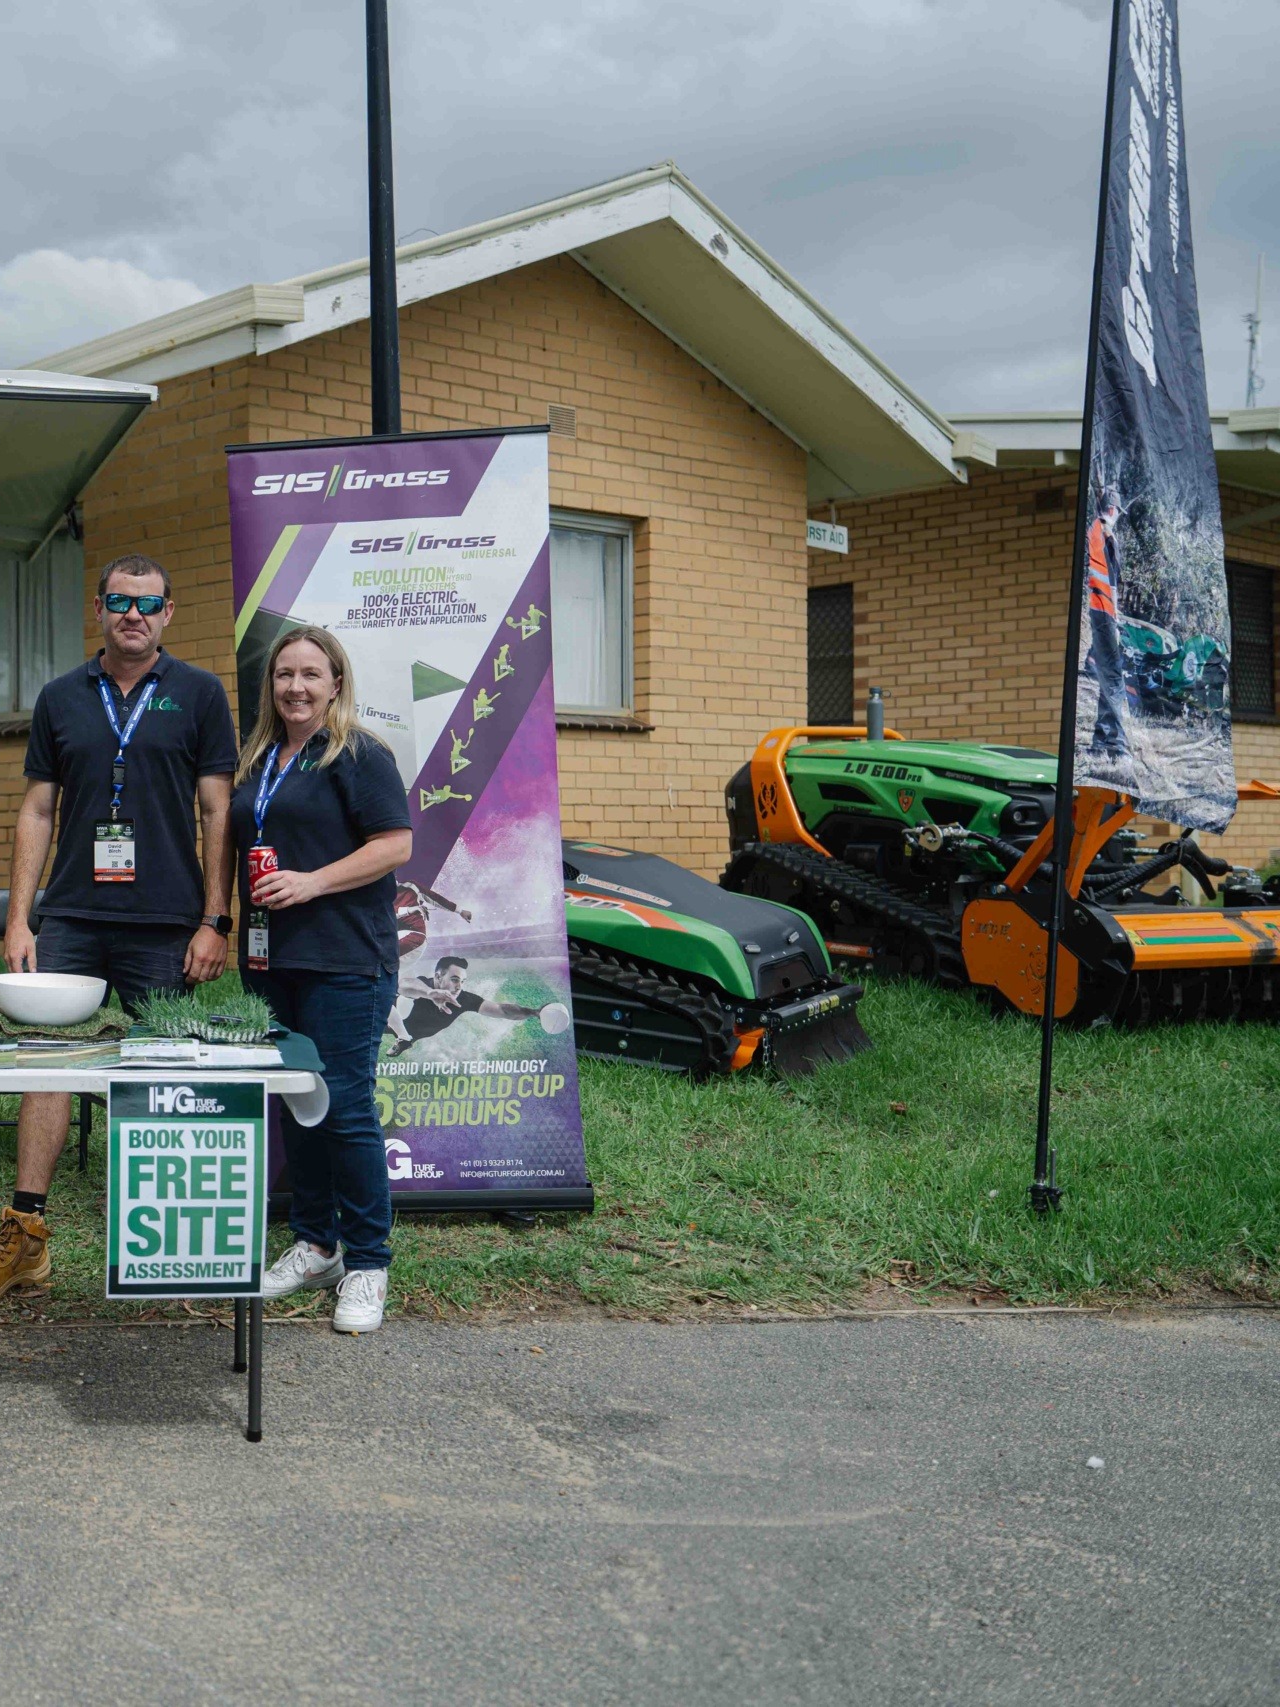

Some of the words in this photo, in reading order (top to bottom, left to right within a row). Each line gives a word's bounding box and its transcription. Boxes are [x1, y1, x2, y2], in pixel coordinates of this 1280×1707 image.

[251, 472, 326, 495] SIS
[343, 470, 450, 490] Grass
[806, 525, 827, 541] IRST
[829, 531, 845, 545] AID
[350, 536, 405, 554] SIS
[417, 535, 496, 549] Grass
[461, 548, 517, 559] UNIVERSAL
[352, 567, 447, 587] REVOLUTION
[447, 566, 454, 574] IN
[447, 573, 472, 581] HYBRID
[380, 584, 416, 594] SURFACE
[419, 582, 456, 591] SYSTEMS
[362, 594, 399, 608] 100%
[401, 590, 458, 606] ELECTRIC
[347, 606, 397, 620] BESPOKE
[400, 603, 476, 617] INSTALLATION
[362, 618, 396, 629] VARIETY
[397, 618, 408, 627] OF
[409, 616, 428, 626] NEW
[429, 614, 487, 625] APPLICATIONS
[366, 706, 400, 722] Grass
[871, 764, 909, 780] 600
[422, 1061, 459, 1075] PITCH
[462, 1059, 547, 1074] TECHNOLOGY
[397, 1082, 431, 1100] 2018
[434, 1075, 513, 1099] WORLD
[518, 1074, 565, 1098] CUP
[149, 1086, 195, 1114] HG
[195, 1098, 218, 1106] TURF
[195, 1105, 225, 1113] GROUP
[395, 1100, 521, 1127] STADIUMS
[128, 1129, 184, 1149] BOOK
[192, 1130, 246, 1149] YOUR
[385, 1138, 413, 1181] G
[413, 1163, 436, 1172] TURF
[473, 1160, 482, 1168] (0)
[128, 1155, 247, 1200] FREE
[414, 1170, 444, 1179] GROUP
[460, 1169, 565, 1178] INFO@HGTURFGROUP.COM.AU
[126, 1205, 246, 1257] SITE
[125, 1262, 246, 1279] ASSESSMENT
